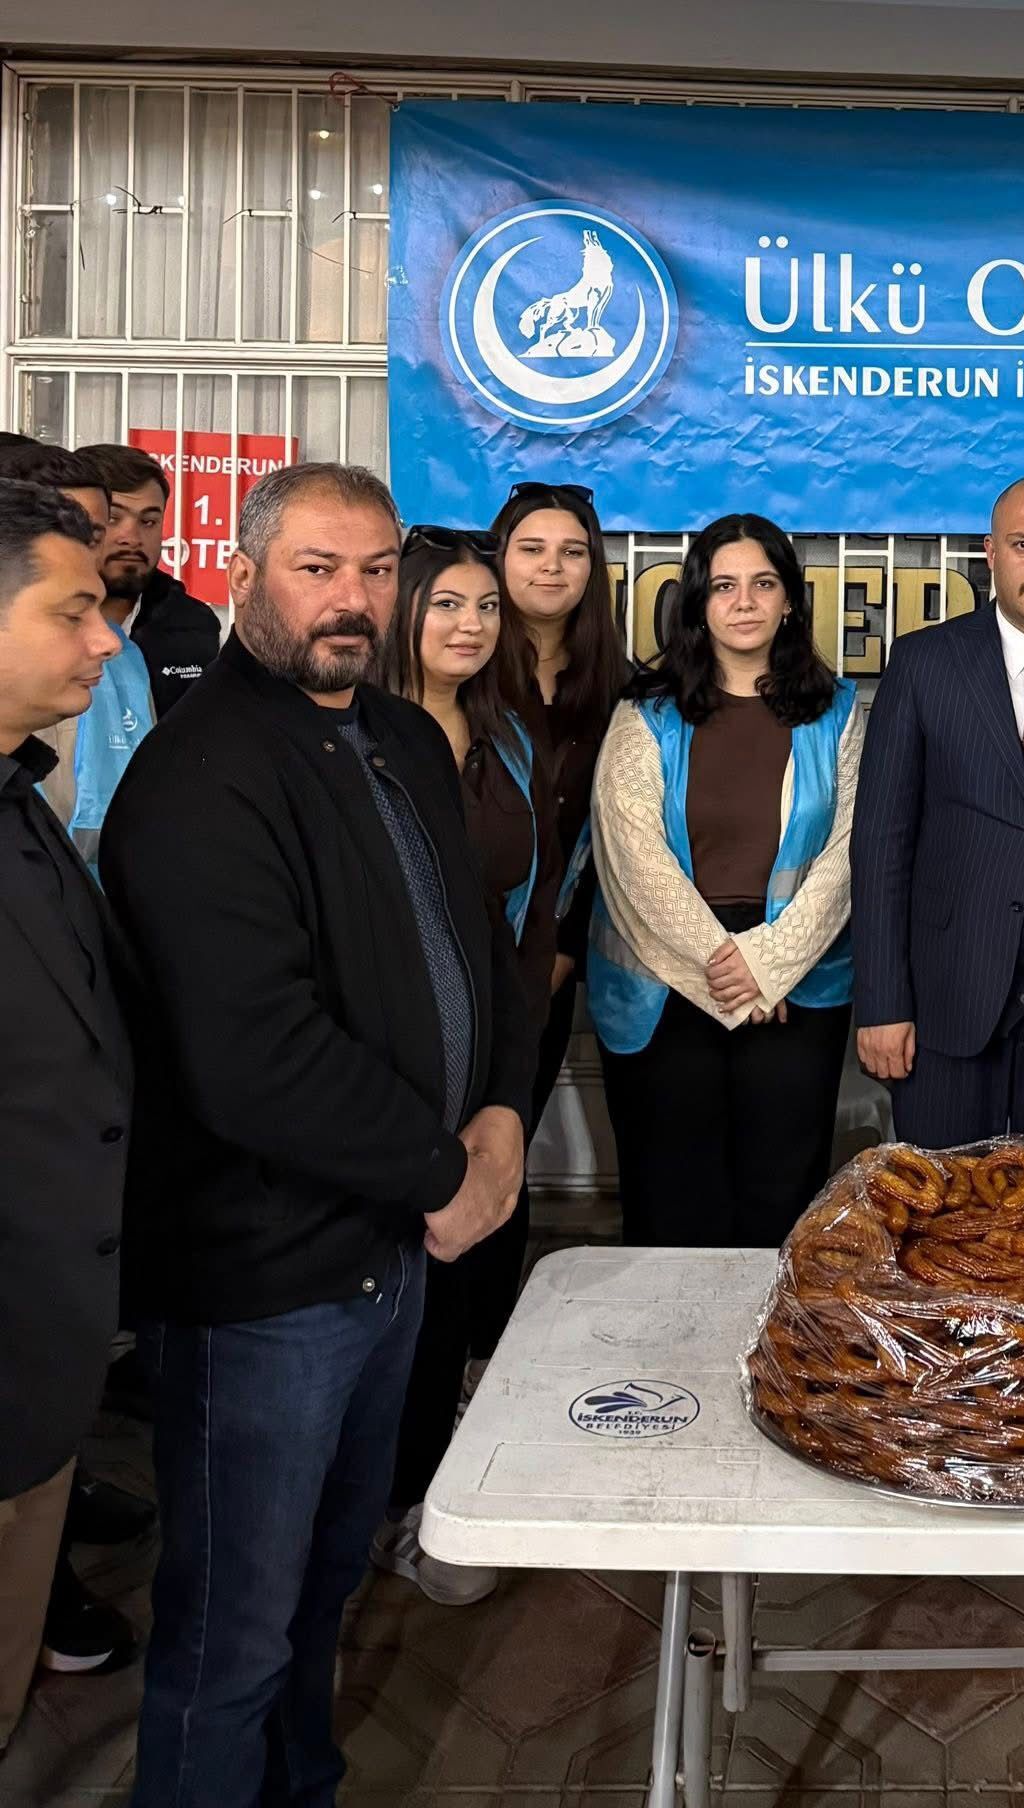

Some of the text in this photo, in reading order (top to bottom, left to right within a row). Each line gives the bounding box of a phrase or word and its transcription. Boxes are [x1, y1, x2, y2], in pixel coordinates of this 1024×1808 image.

[745, 235, 925, 334] Ülkü
[744, 356, 999, 398] İSKENDERUN
[194, 494, 223, 526] 1.
[577, 1412, 688, 1424] İSKENDERUN
